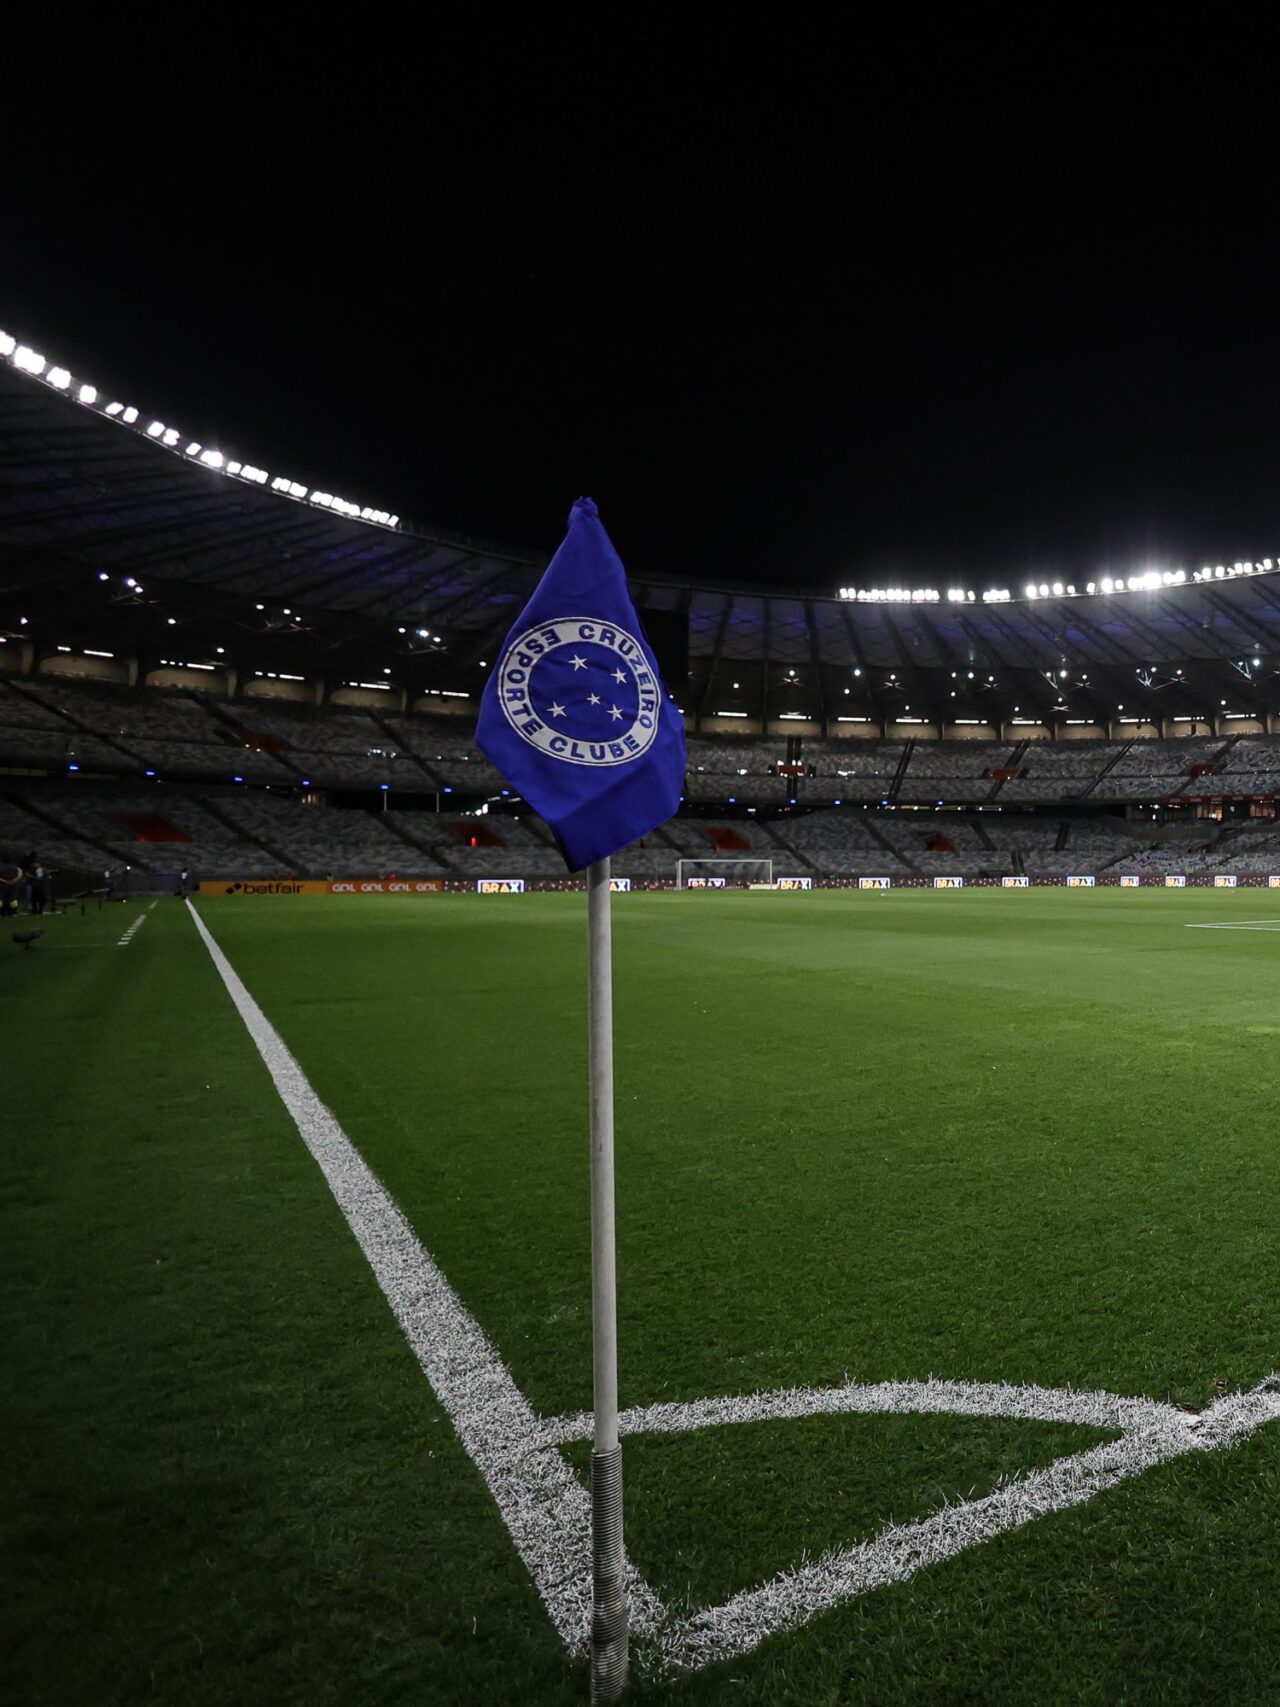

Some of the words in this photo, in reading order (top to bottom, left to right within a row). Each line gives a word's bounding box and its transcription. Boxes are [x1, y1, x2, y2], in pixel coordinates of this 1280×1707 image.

[578, 625, 655, 729] CRUZEIRO
[506, 627, 561, 736] ESPORTE
[549, 733, 640, 761] CLUBE
[609, 882, 627, 892] AX
[862, 880, 887, 889] BRAX
[936, 879, 960, 888] BRAX
[1004, 879, 1026, 887] BRAX
[1069, 878, 1093, 887] BRAX
[1216, 878, 1235, 887] BRAX
[244, 882, 304, 894] betfair
[332, 883, 356, 892] GOL
[361, 883, 384, 892] GOL
[389, 883, 411, 891] GOL
[416, 883, 438, 891] GOL
[482, 882, 520, 893] BRAX
